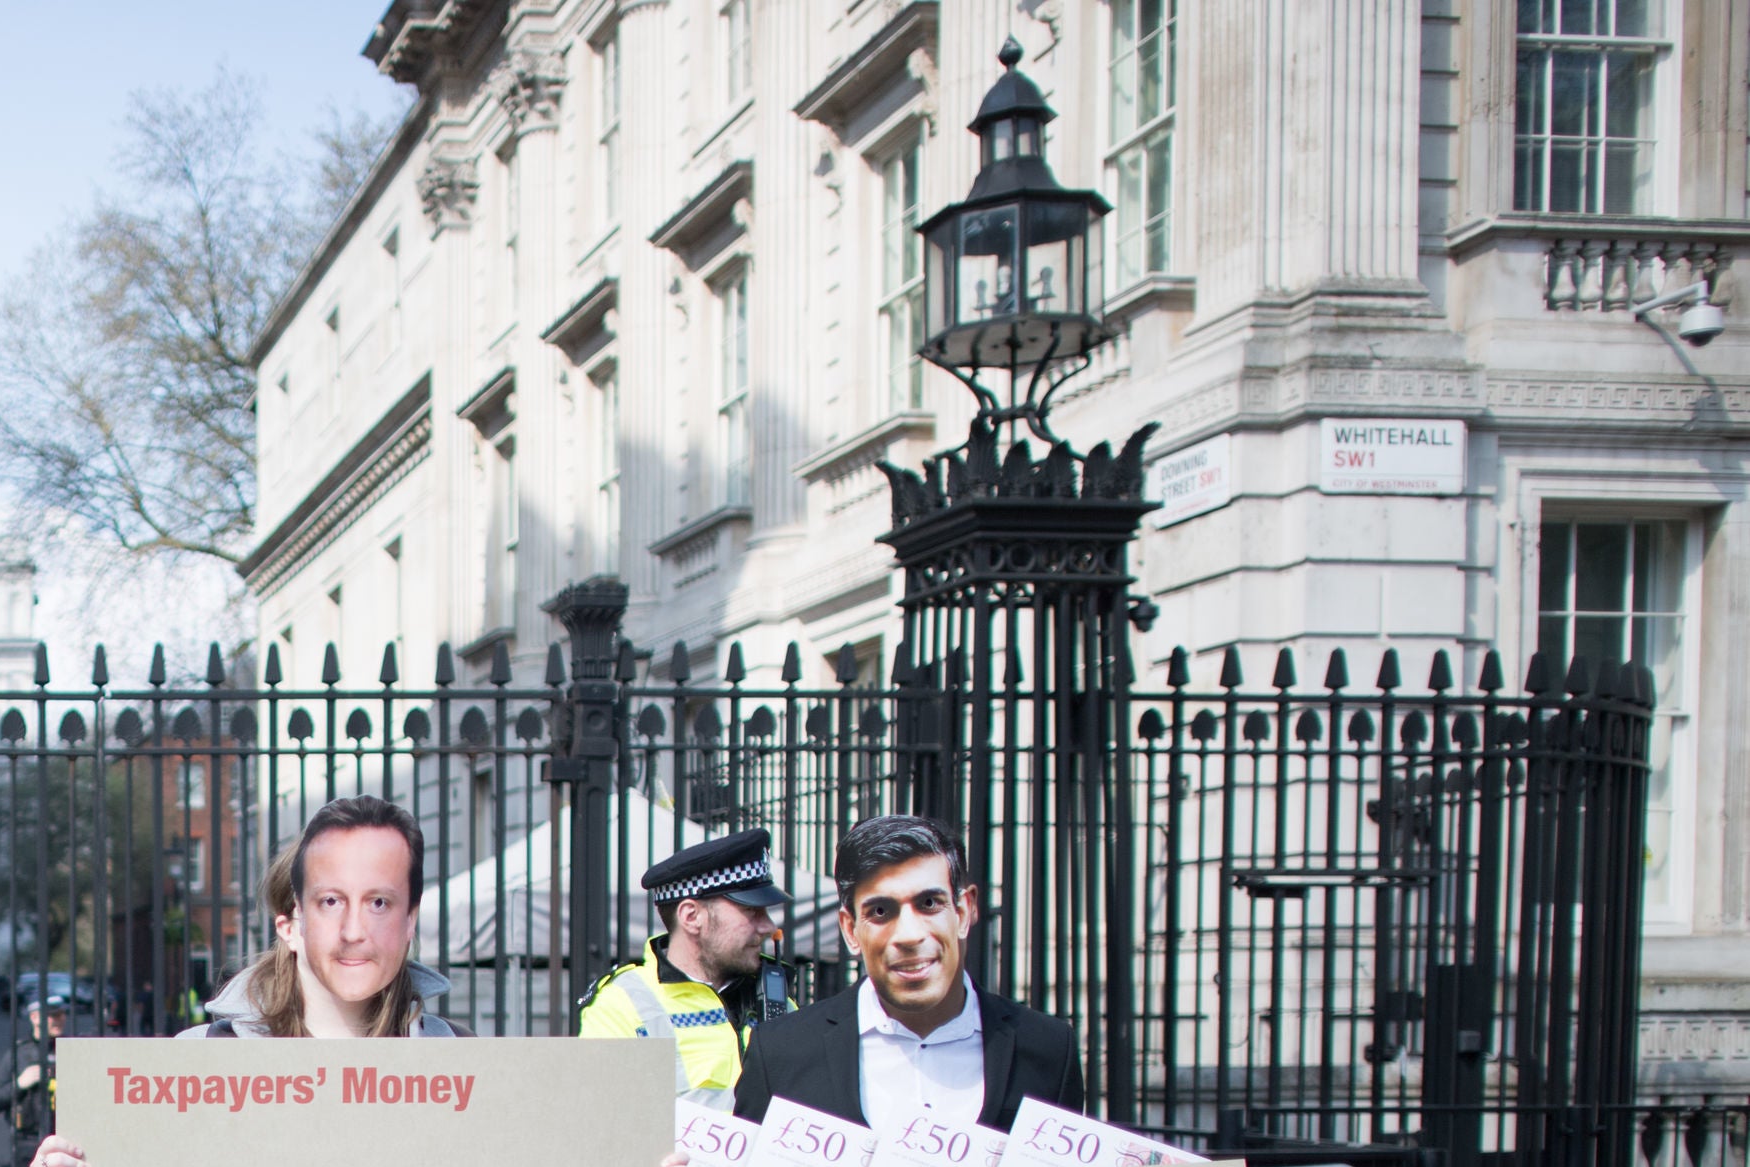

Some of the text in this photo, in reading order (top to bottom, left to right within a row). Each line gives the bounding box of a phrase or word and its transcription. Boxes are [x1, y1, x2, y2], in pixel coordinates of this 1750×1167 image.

[1334, 427, 1453, 446] WHITEHALL
[1161, 449, 1207, 481] DOWNING
[1334, 450, 1375, 468] SW1
[1162, 467, 1221, 498] STREET SW1
[1332, 479, 1438, 489] CITY OF WESTMINSTER
[107, 1067, 475, 1112] Taxpayers’ Money
[675, 1116, 748, 1161] £50
[772, 1116, 846, 1162] £50
[895, 1116, 971, 1163] £50
[1024, 1117, 1101, 1164] £50
